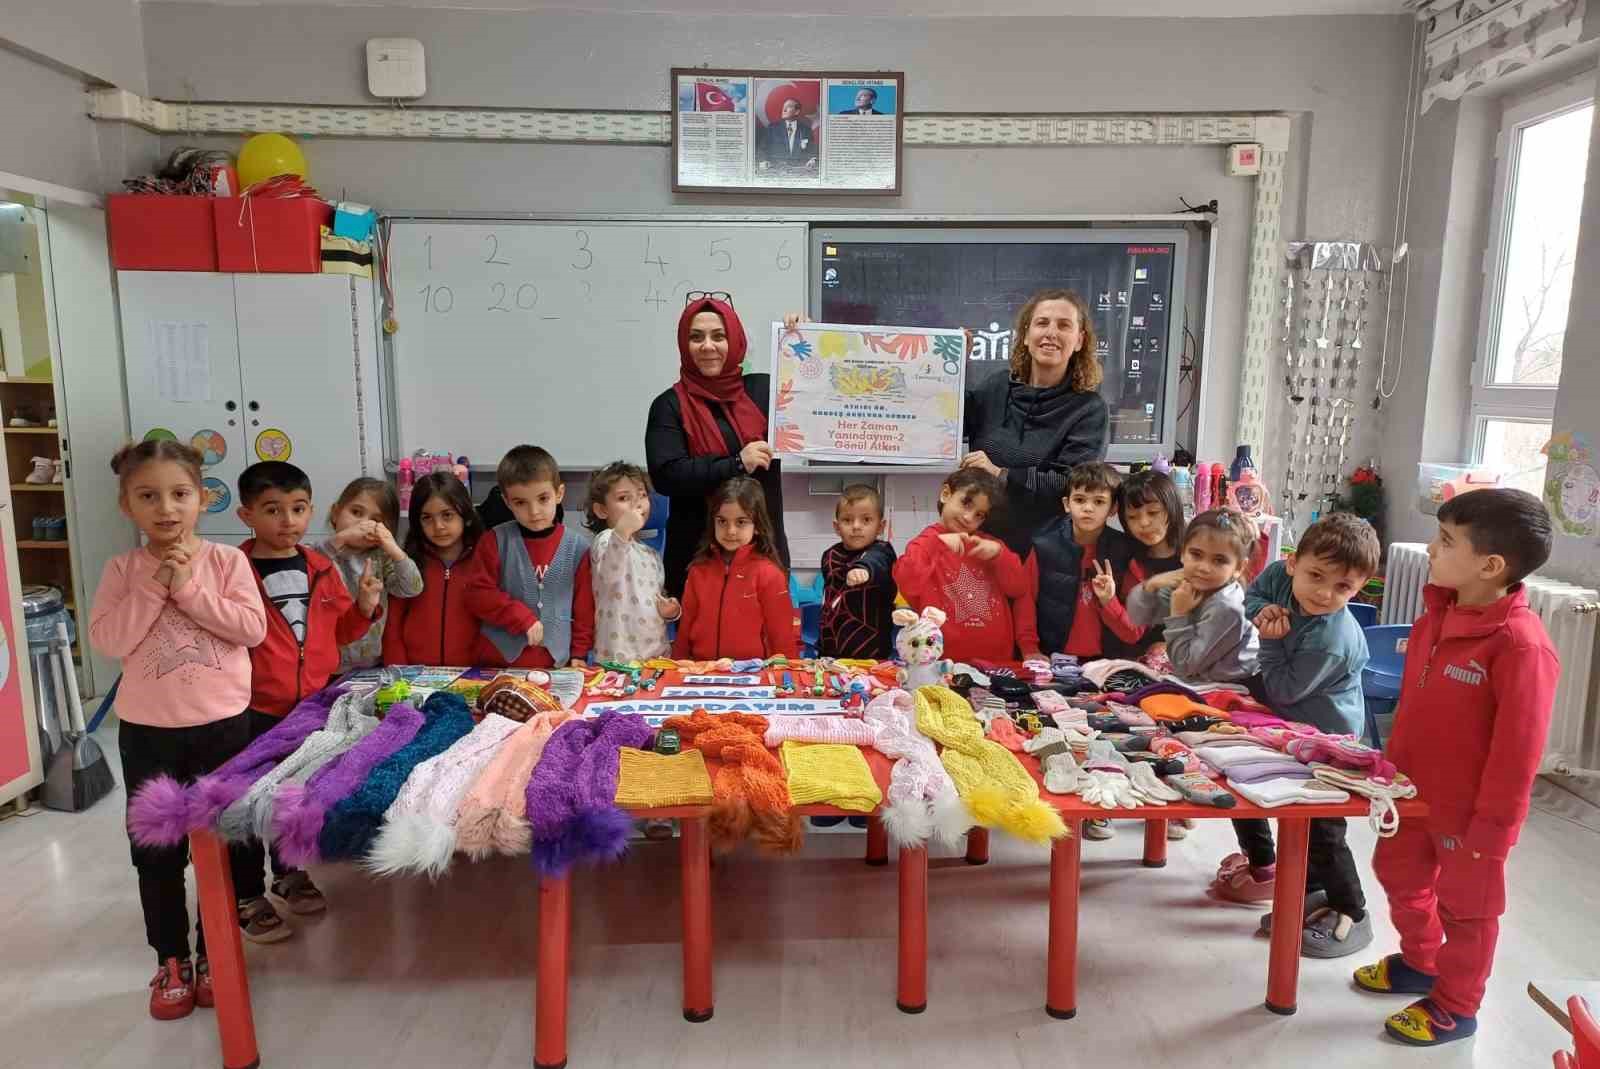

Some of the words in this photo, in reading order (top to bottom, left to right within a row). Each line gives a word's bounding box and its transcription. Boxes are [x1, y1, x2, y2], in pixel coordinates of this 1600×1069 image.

[423, 234, 433, 271] 1
[483, 233, 513, 266] 2
[570, 229, 594, 271] 3
[643, 233, 670, 276] 4
[708, 237, 734, 273] 5
[775, 239, 793, 272] 6
[417, 283, 454, 314] 10
[487, 281, 539, 313] 20
[837, 419, 858, 430] Her
[860, 420, 899, 431] Zaman
[834, 439, 868, 450] Gönül
[869, 440, 901, 452] Atkısı
[1443, 663, 1482, 686] PUMA
[666, 689, 770, 697] ZAMAN
